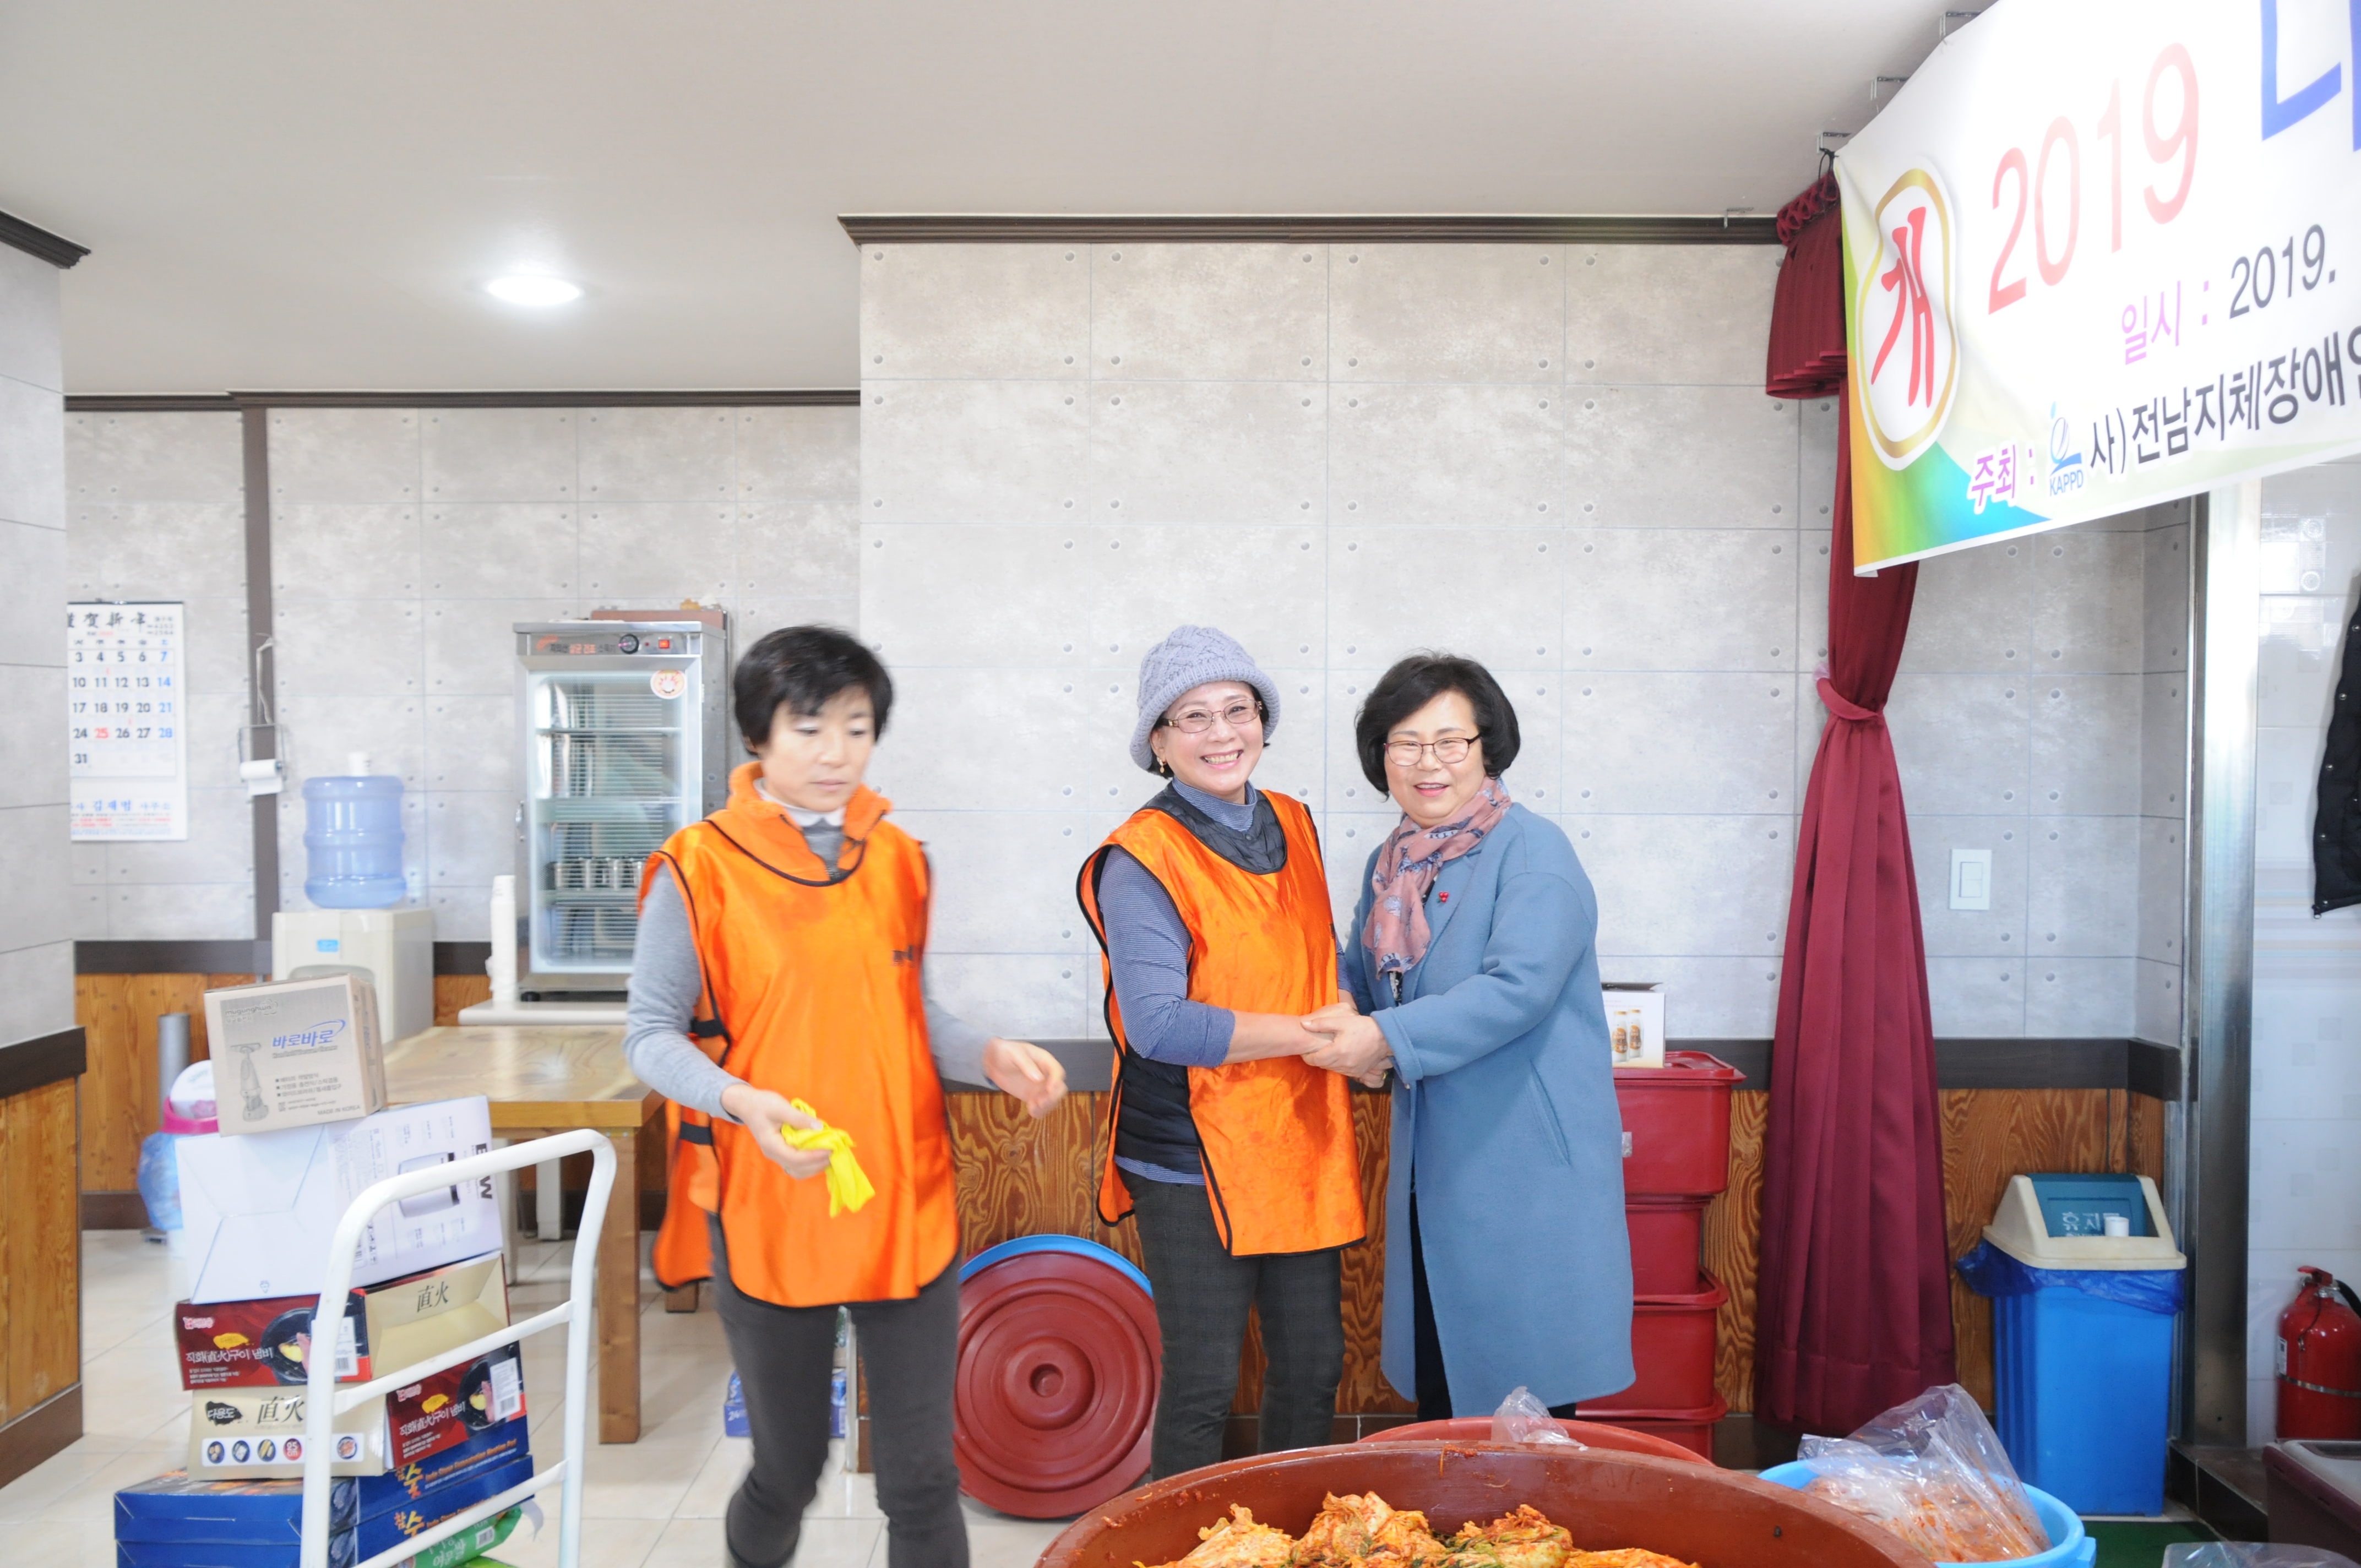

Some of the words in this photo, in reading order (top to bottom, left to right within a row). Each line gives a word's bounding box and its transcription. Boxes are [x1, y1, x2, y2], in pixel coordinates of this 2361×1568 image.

[1988, 42, 2200, 314] 2019
[2121, 280, 2181, 366] 일시
[2229, 224, 2336, 319] 2019.
[1871, 206, 1934, 408] 개
[1972, 444, 2016, 507] 주최
[2049, 469, 2084, 497] KAPPD
[76, 652, 83, 662] 3
[97, 652, 104, 662] 4
[117, 651, 124, 662] 5
[139, 652, 146, 662] 6
[161, 651, 167, 662] 7
[73, 677, 86, 687] 10
[95, 677, 107, 687] 11
[115, 677, 128, 687] 12
[136, 677, 149, 687] 13
[158, 677, 171, 687] 14
[73, 703, 86, 712] 17
[95, 703, 107, 712] 18
[116, 703, 128, 712] 19
[137, 703, 150, 712] 20
[159, 702, 172, 712] 21
[74, 728, 88, 738] 24
[95, 728, 108, 738] 25
[116, 728, 129, 738] 26
[137, 728, 150, 738] 27
[159, 728, 173, 738] 28
[74, 754, 88, 764] 31
[225, 1004, 272, 1016] mugunghwa
[273, 1029, 334, 1049] 바로바로
[2062, 1212, 2119, 1232] 휴지
[417, 1281, 448, 1313] 直火
[252, 1347, 274, 1360] 냄비
[257, 1395, 306, 1424] 直火
[286, 1442, 298, 1451] 25
